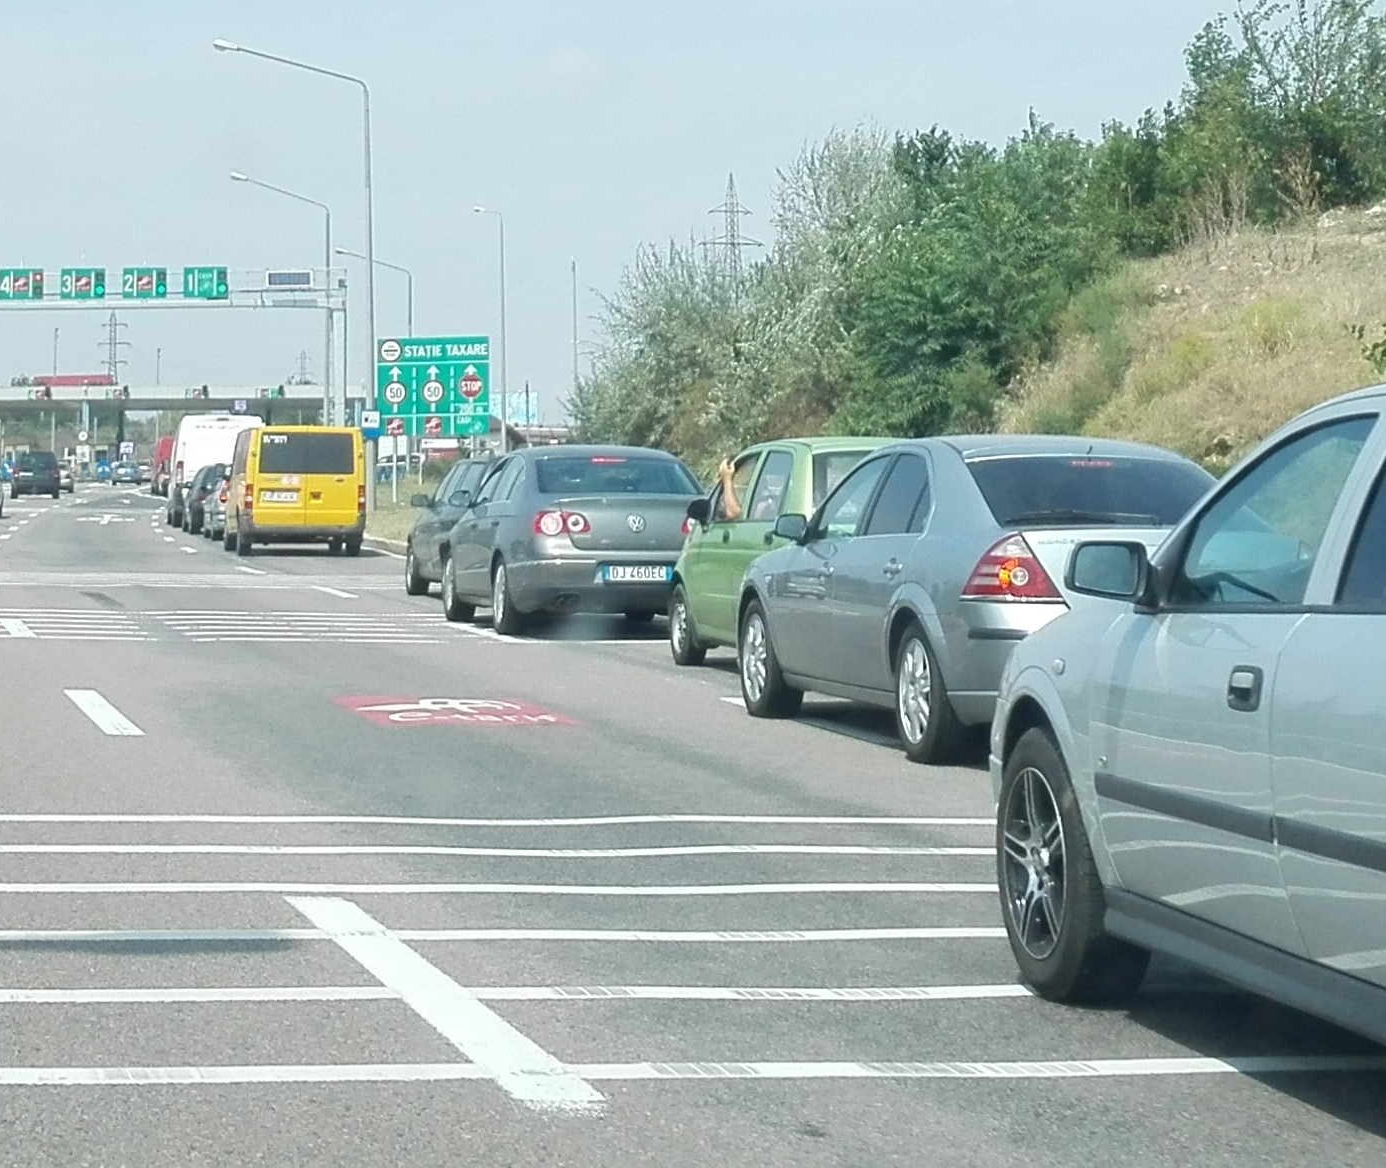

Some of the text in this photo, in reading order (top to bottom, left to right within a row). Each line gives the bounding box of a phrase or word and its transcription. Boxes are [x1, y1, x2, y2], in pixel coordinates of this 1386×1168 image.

[0, 275, 10, 293] 4
[62, 275, 72, 293] 3
[124, 274, 133, 292] 2
[187, 273, 193, 292] 1
[445, 343, 488, 356] TAXARE
[389, 387, 402, 399] 50
[427, 386, 440, 398] 50
[460, 380, 482, 392] STOP
